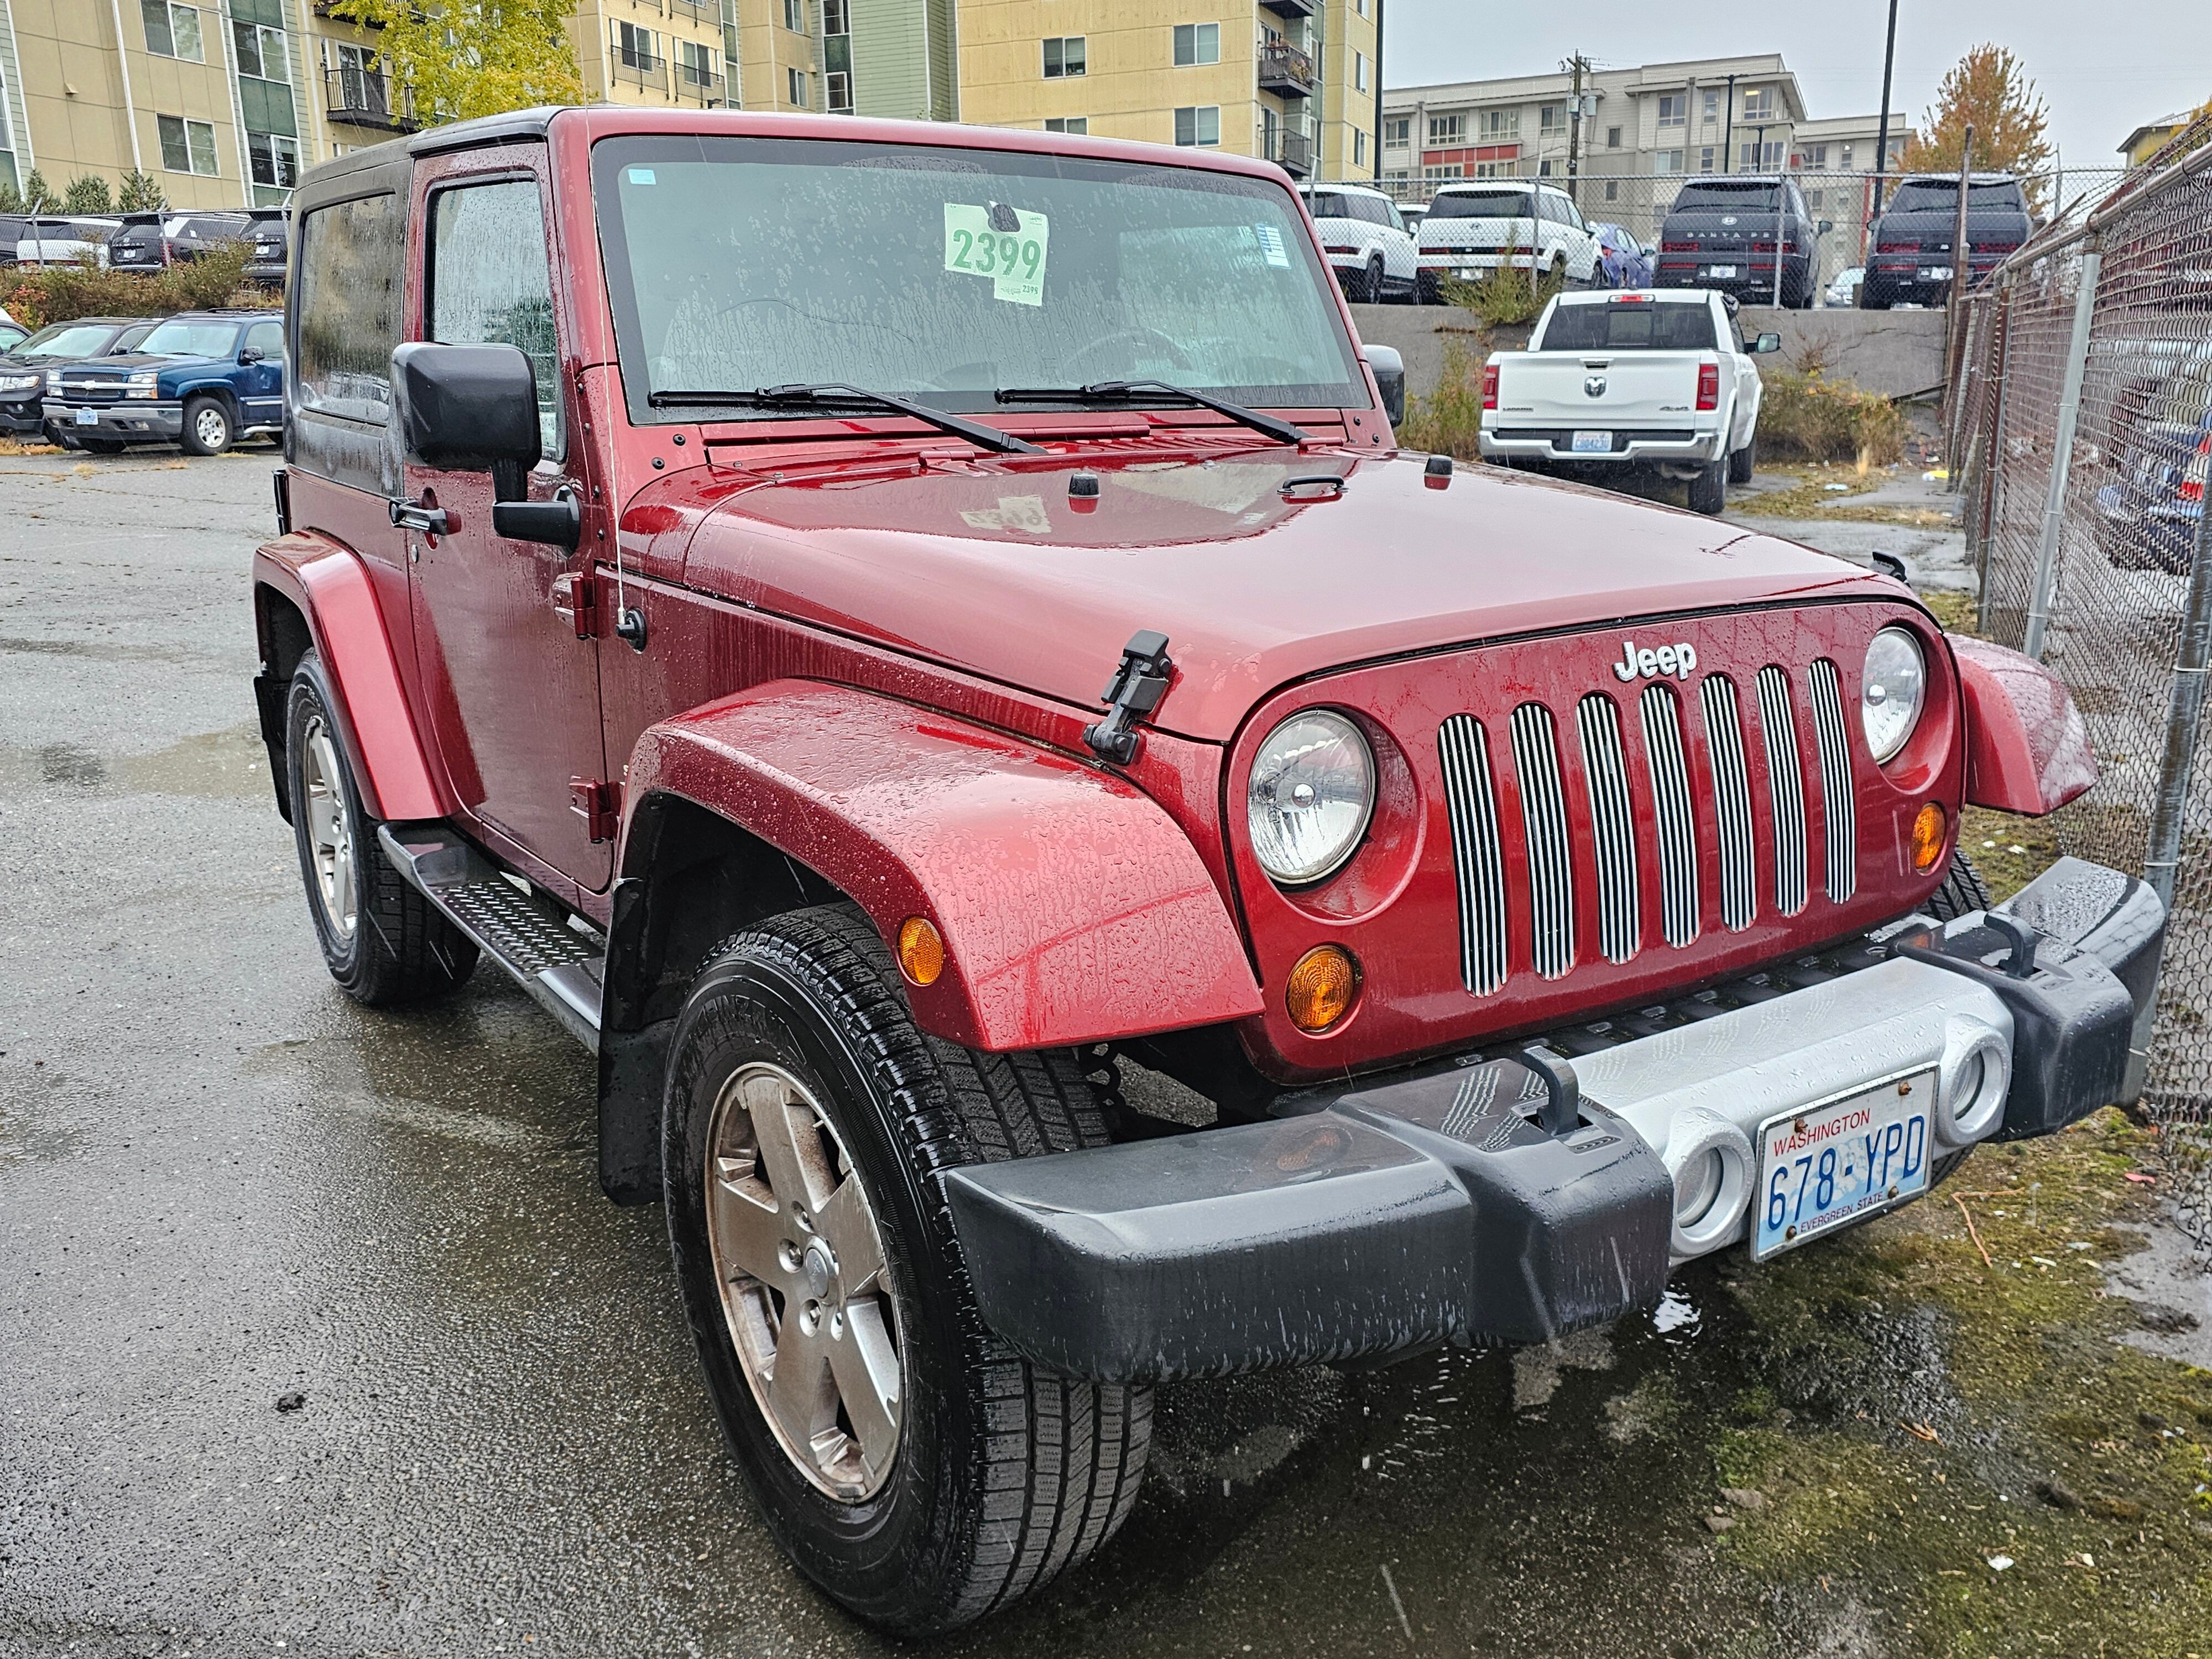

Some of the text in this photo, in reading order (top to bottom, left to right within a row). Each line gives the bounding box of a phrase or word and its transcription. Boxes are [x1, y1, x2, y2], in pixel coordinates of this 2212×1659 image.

[953, 229, 1041, 280] 2399
[1613, 640, 1697, 682] Jeep
[1773, 1108, 1871, 1156] WASHINGTON
[1800, 1191, 1884, 1233] EVERGREEN STATE
